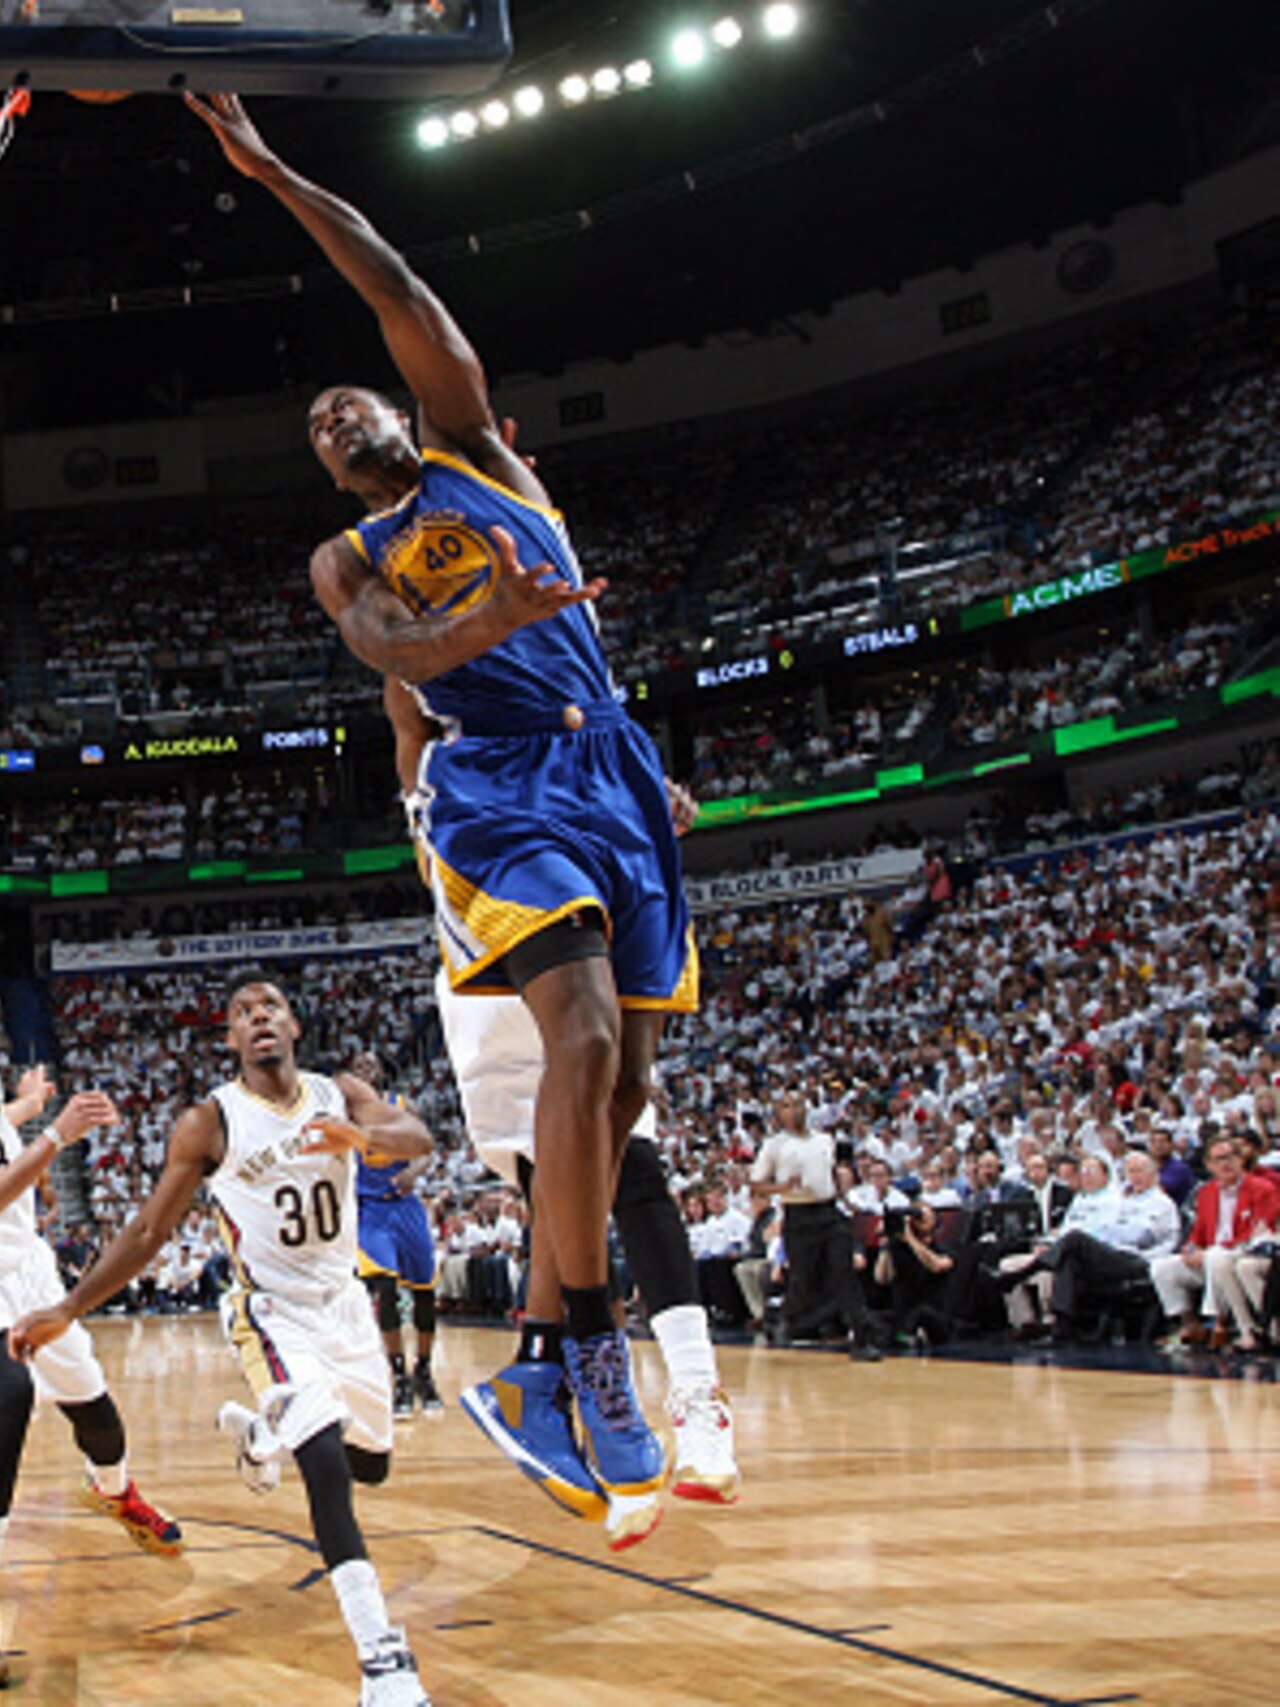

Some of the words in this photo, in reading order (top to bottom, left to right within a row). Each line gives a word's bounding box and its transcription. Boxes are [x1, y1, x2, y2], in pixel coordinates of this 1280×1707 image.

[426, 533, 463, 571] 40
[1164, 535, 1222, 569] ACME
[1010, 561, 1123, 618] ACME
[843, 623, 918, 657] STEALS
[696, 655, 769, 689] BLOCKS
[710, 873, 783, 899] BLOCK
[789, 862, 863, 888] PARTY
[273, 1178, 341, 1247] 30
